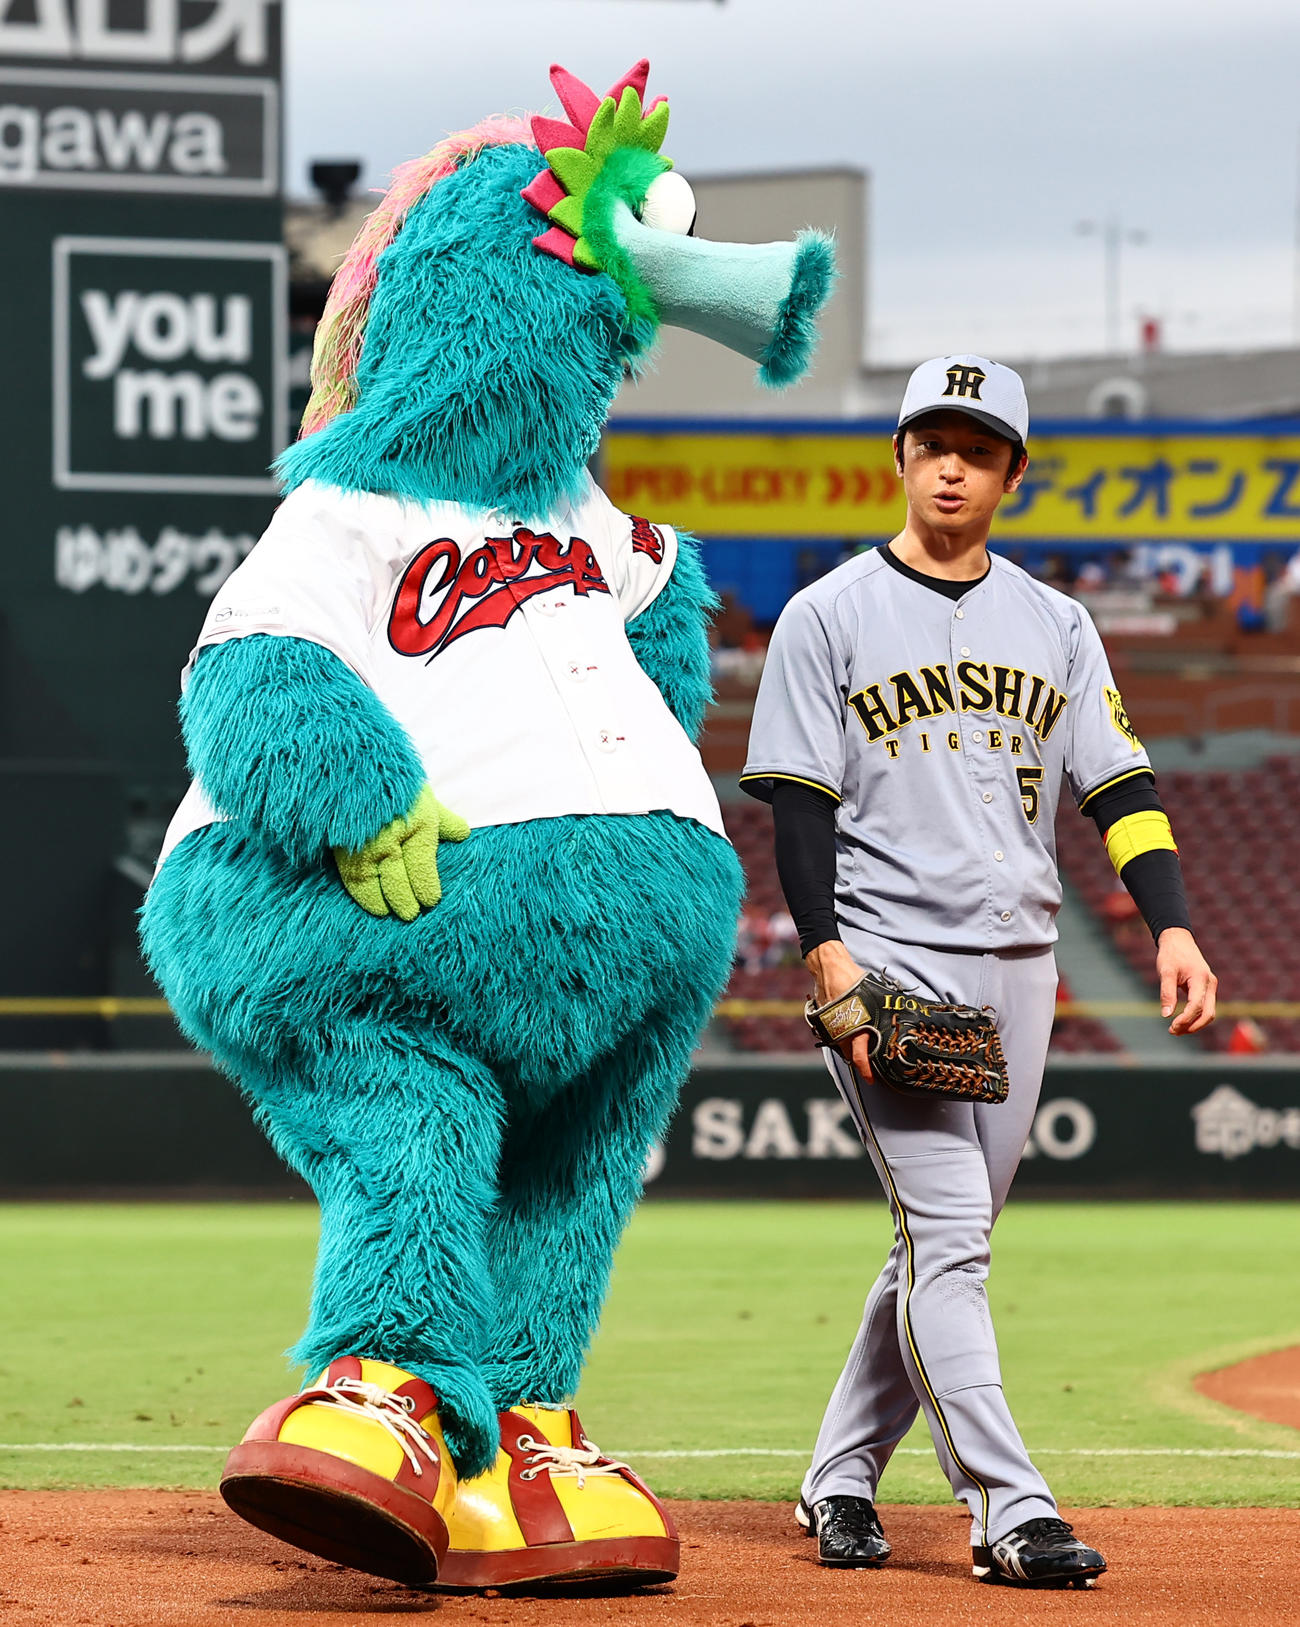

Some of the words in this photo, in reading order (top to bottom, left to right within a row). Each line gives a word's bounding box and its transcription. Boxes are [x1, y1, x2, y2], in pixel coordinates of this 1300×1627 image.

[0, 104, 226, 182] gawa
[80, 289, 252, 380] you
[114, 368, 263, 442] me
[55, 524, 260, 594] ゆめタウ
[387, 527, 613, 667] Carp
[849, 660, 1068, 743] HANSHIN
[885, 729, 1023, 759] TIGER
[1015, 765, 1045, 824] 5
